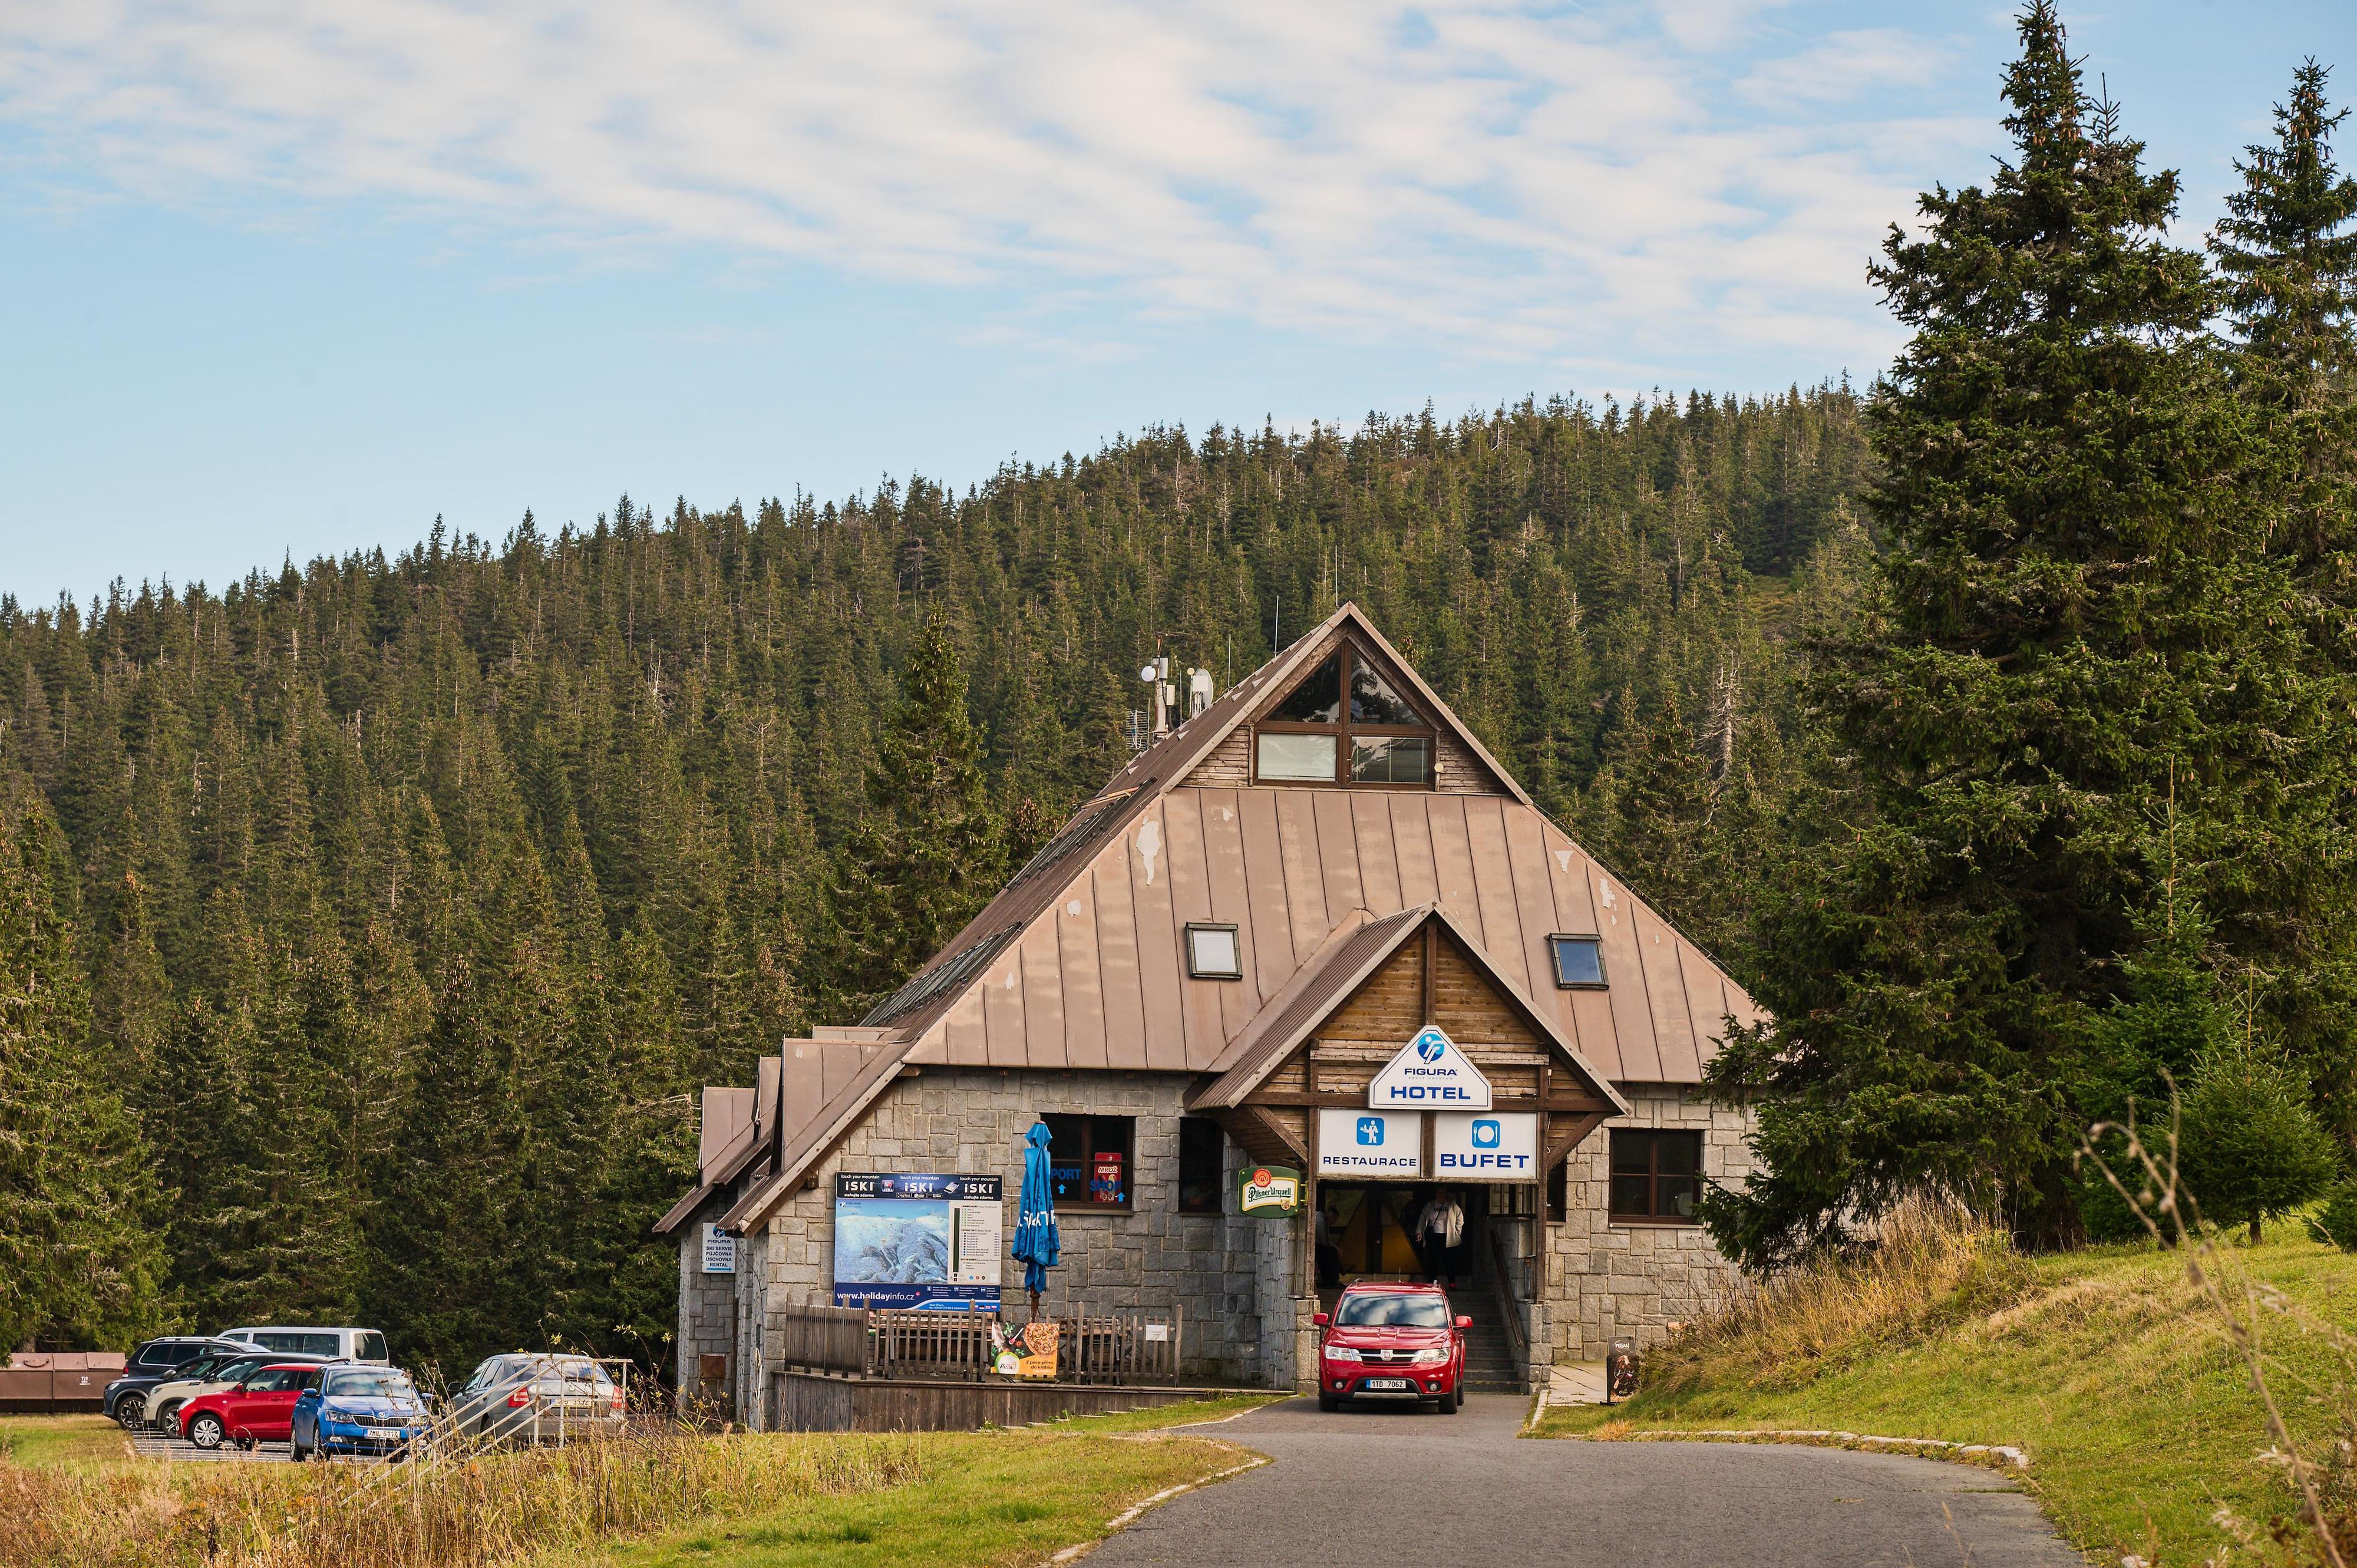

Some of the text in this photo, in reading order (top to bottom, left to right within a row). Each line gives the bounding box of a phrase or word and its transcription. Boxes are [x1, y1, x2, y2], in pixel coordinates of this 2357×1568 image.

[1391, 1086, 1471, 1100] HOTEL
[1323, 1156, 1417, 1166] RESTAURACE
[1440, 1153, 1529, 1168] BUFET
[1051, 1168, 1081, 1180] PORT
[1098, 1166, 1118, 1174] MROŽ
[845, 1181, 873, 1191] iSKI
[904, 1183, 932, 1192] iSKI
[964, 1183, 993, 1193] iSKI
[1090, 1180, 1122, 1191] SHOP
[1248, 1186, 1291, 1202] Pilsner Urquell
